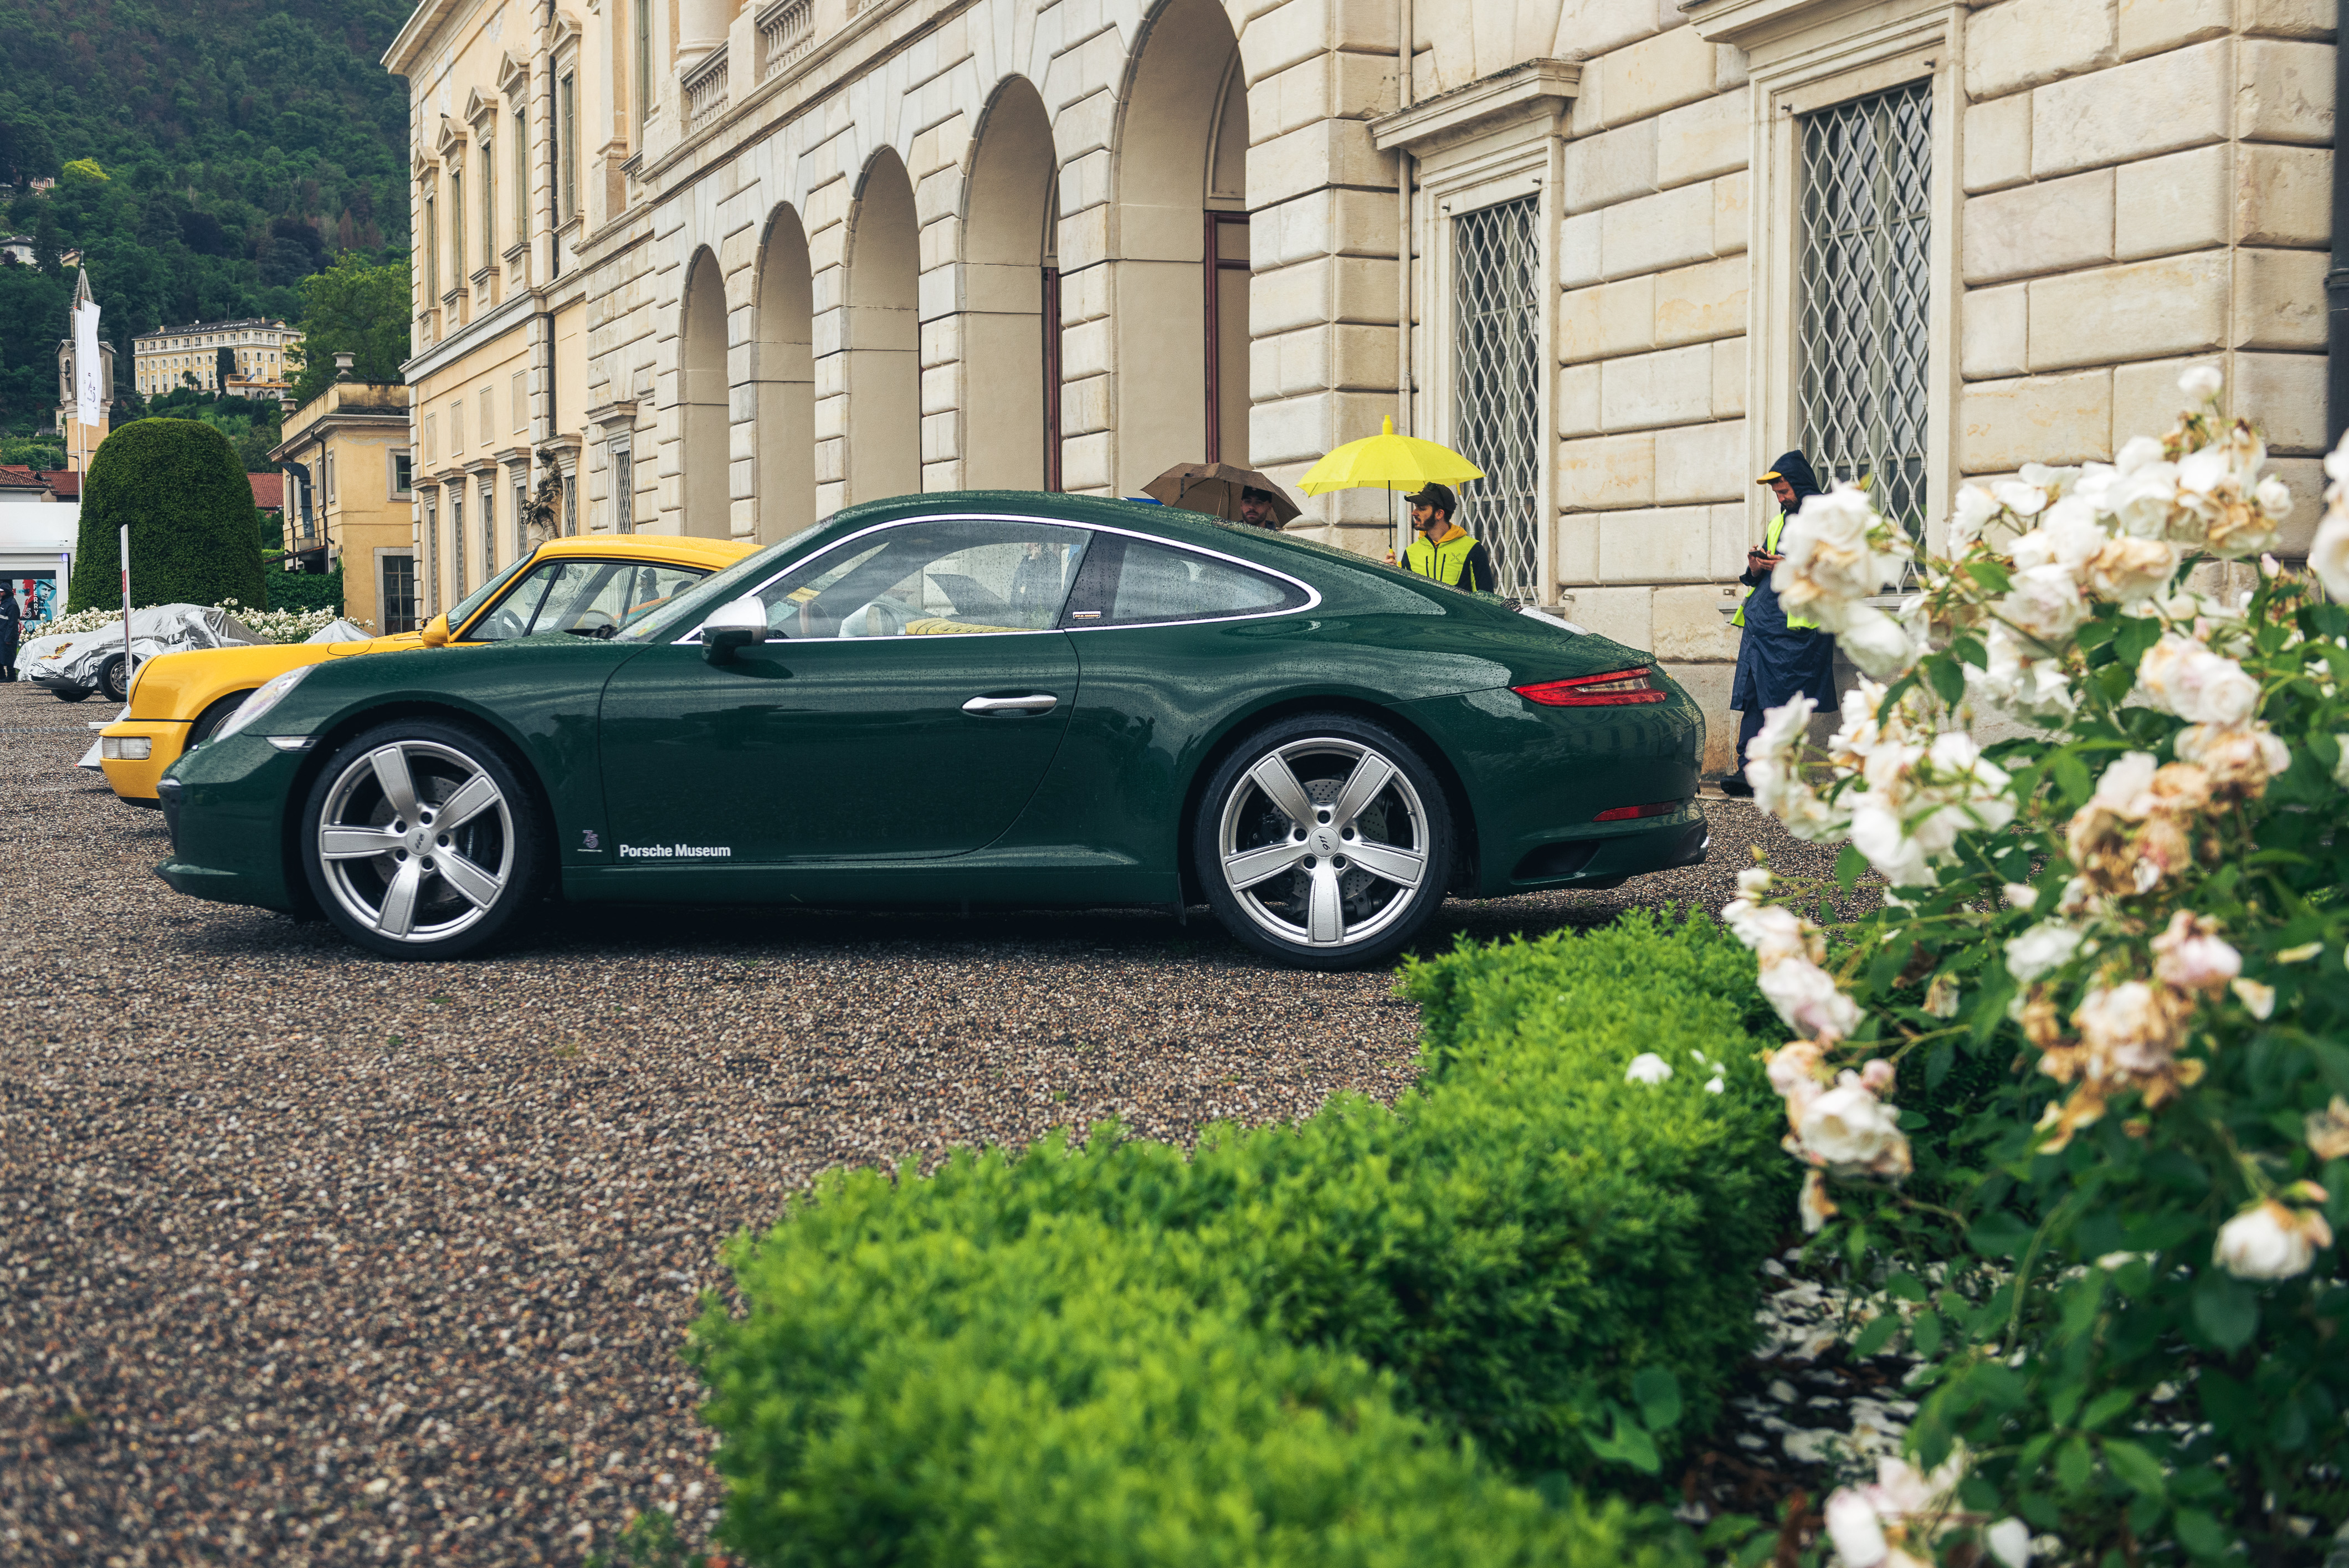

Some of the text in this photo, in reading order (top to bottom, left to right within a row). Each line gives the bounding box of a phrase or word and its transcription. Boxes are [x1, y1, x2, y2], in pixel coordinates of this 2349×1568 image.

[583, 829, 598, 848] 75
[1319, 836, 1330, 850] 911
[619, 844, 731, 857] Porsche Museum
